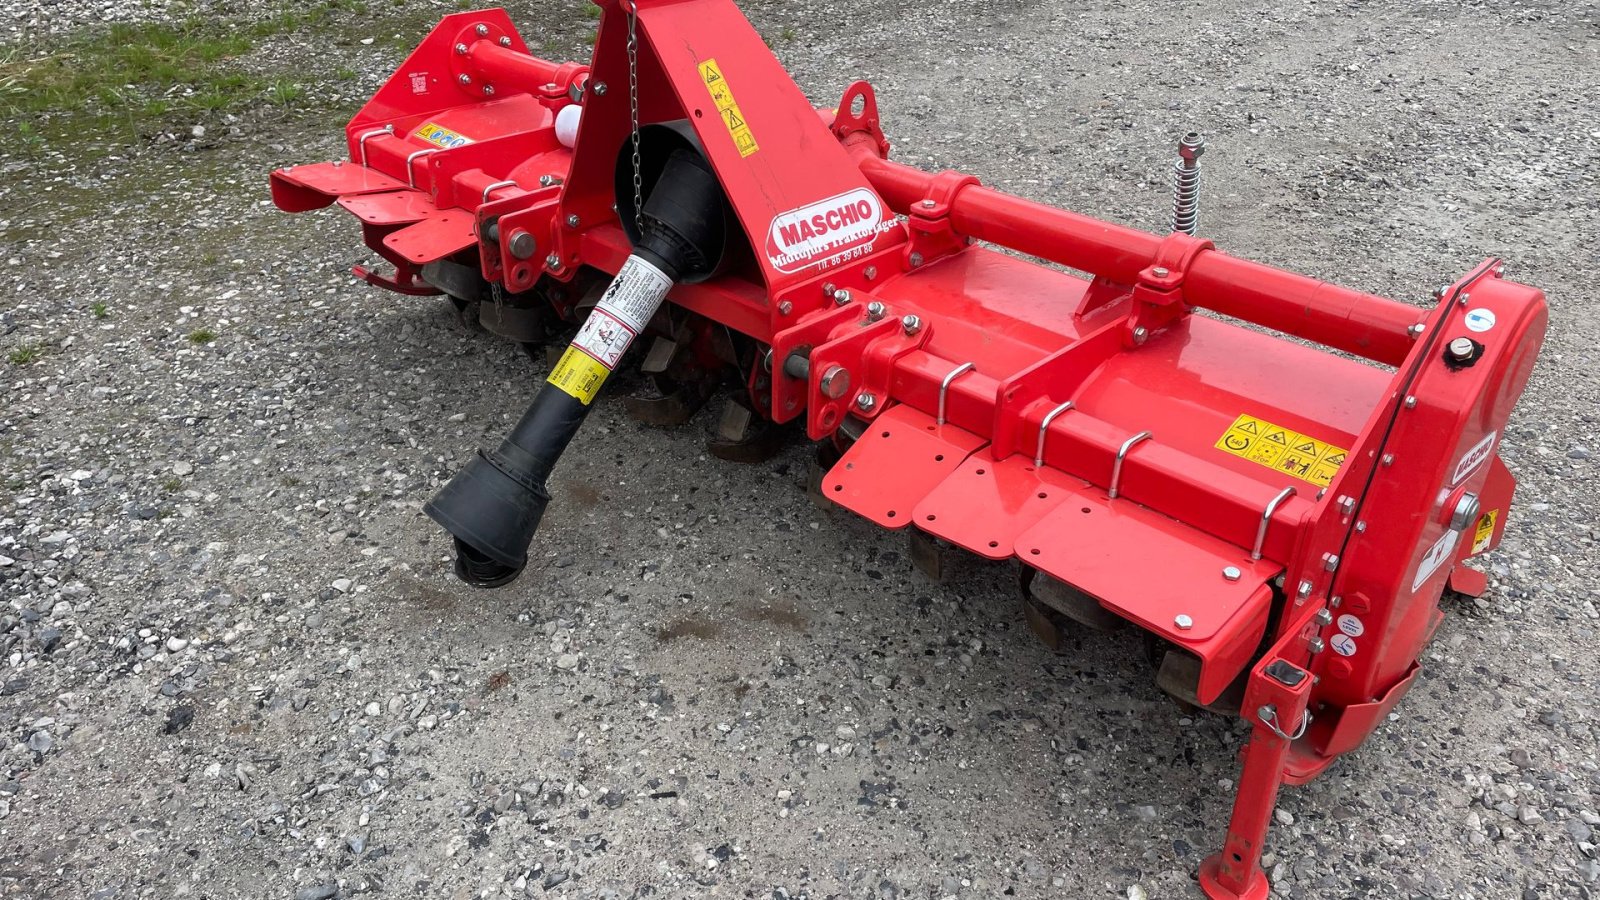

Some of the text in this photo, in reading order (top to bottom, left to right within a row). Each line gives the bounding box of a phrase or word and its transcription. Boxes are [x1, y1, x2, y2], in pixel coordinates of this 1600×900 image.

[780, 199, 872, 248] MASCHIO
[831, 257, 841, 266] 86
[843, 251, 851, 262] 39
[853, 247, 863, 257] 84
[864, 243, 873, 254] 88
[1231, 439, 1243, 447] 540
[1252, 455, 1269, 464] STOP
[1457, 438, 1493, 473] MASCHIO
